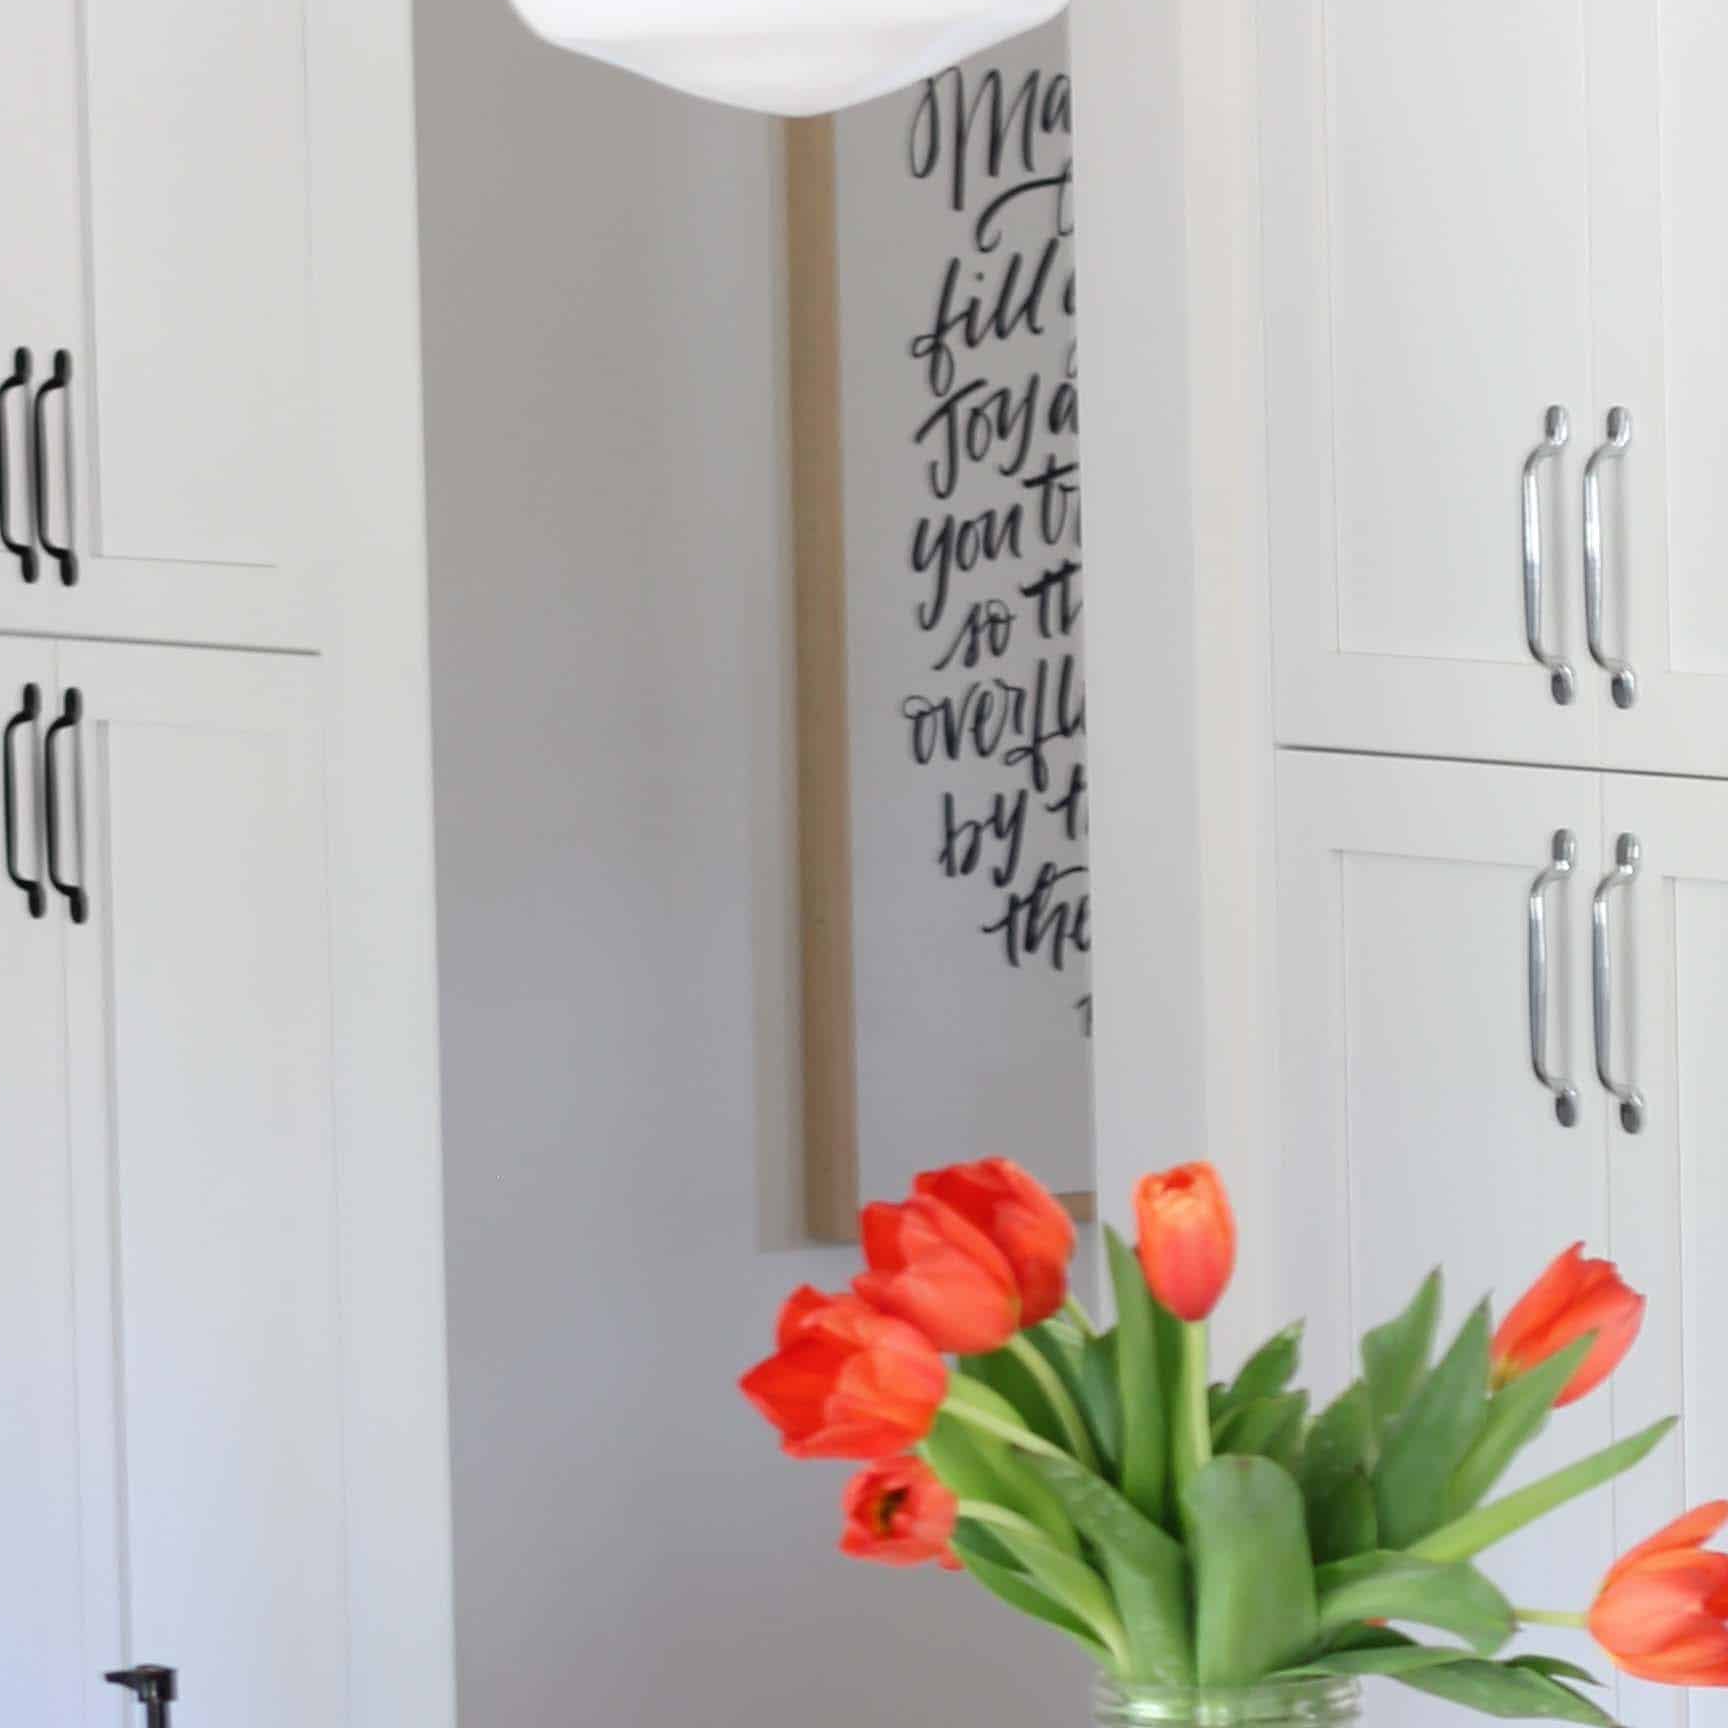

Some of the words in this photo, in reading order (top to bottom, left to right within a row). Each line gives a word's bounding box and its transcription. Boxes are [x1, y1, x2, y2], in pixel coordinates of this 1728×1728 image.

[912, 238, 1059, 397] fill
[914, 373, 1041, 499] Joy
[912, 503, 1022, 631] you
[933, 599, 1016, 670] so
[902, 655, 1086, 792] overfl
[939, 788, 1027, 887] by
